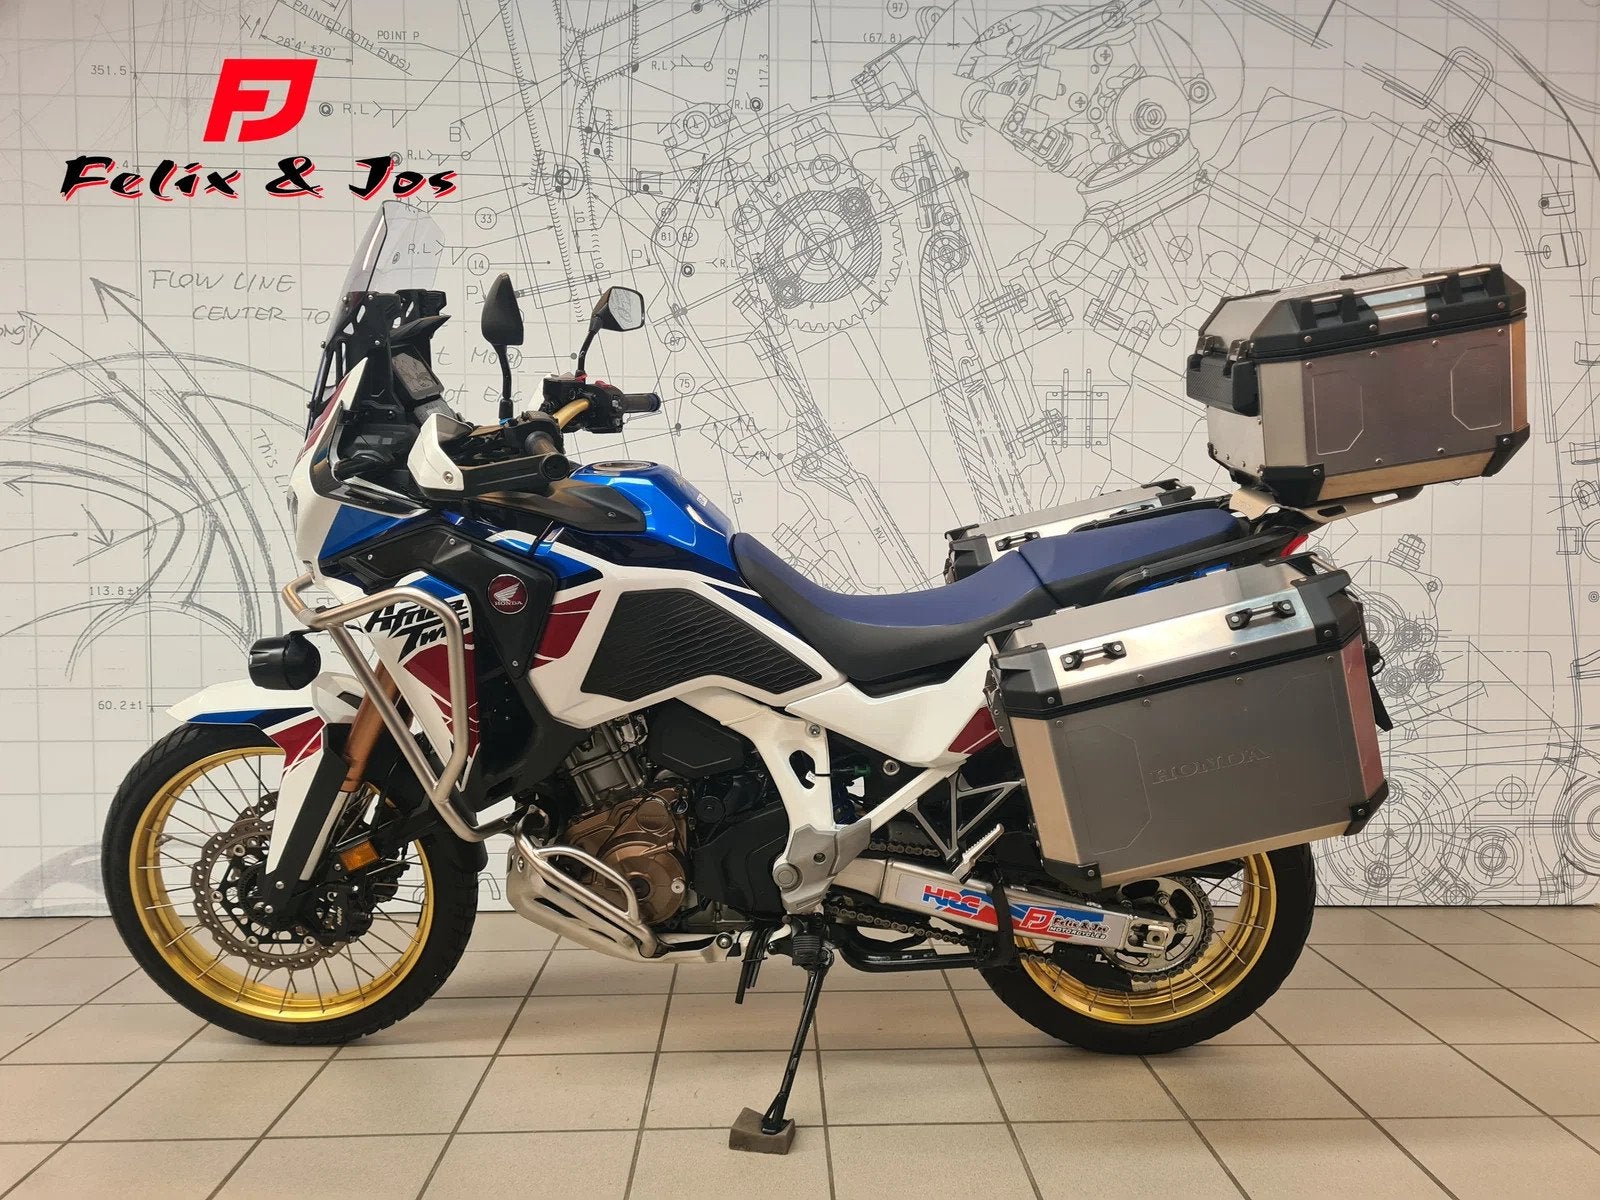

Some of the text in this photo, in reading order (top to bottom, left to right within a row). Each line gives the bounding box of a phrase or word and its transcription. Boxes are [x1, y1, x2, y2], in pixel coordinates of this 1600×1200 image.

[378, 30, 420, 41] POINT P
[90, 65, 127, 76] 351.5
[450, 127, 461, 142] B
[480, 214, 492, 223] 33
[631, 250, 642, 264] P
[474, 260, 484, 269] 14
[149, 270, 296, 293] FLOW LINE
[467, 286, 478, 300] P
[192, 305, 330, 324] CENTER TO
[679, 379, 690, 388] 75
[98, 700, 142, 710] 60.2±1
[1148, 745, 1270, 784] HONDA
[922, 884, 981, 915] HRC
